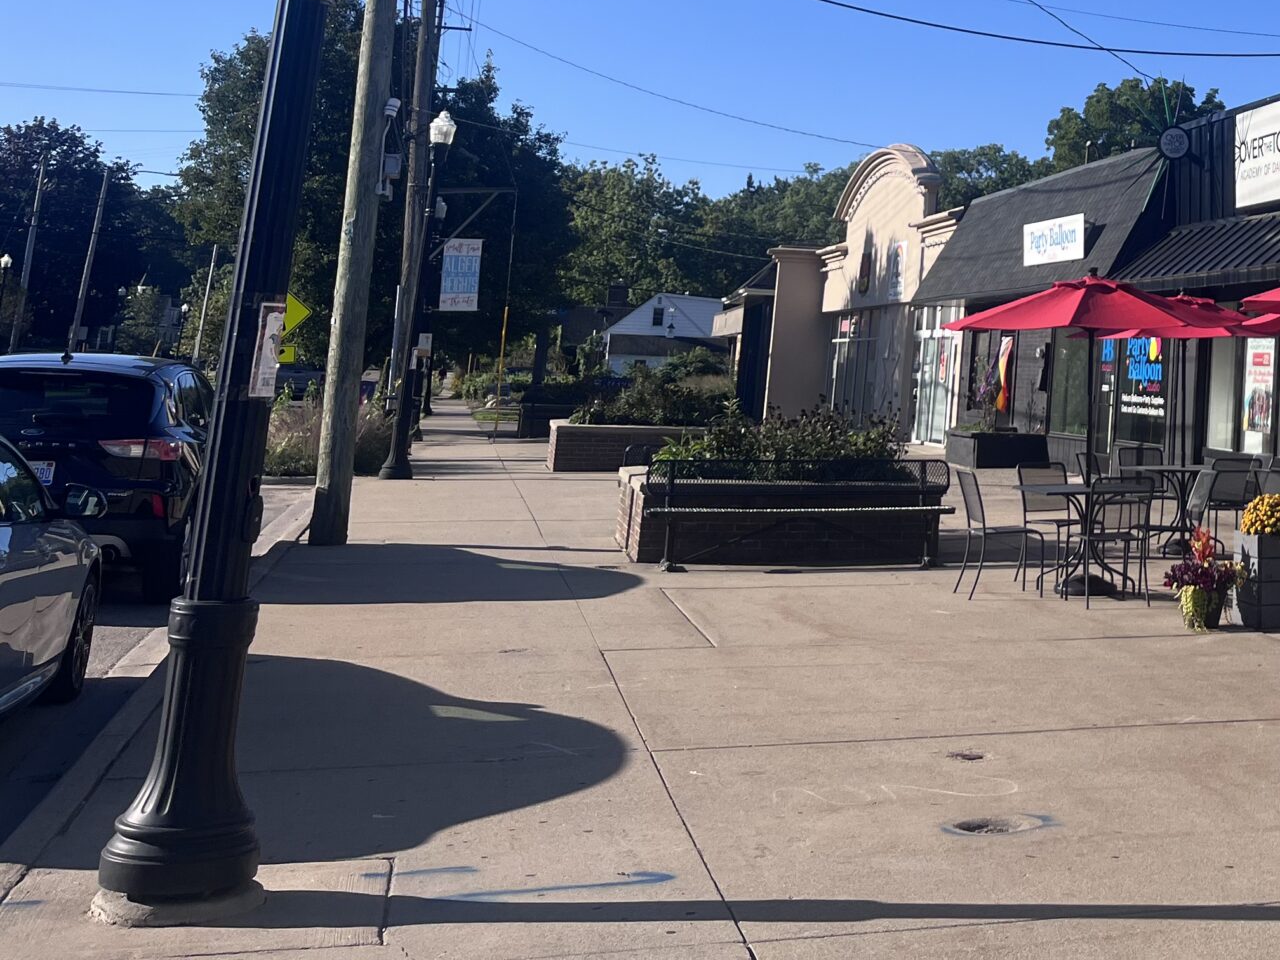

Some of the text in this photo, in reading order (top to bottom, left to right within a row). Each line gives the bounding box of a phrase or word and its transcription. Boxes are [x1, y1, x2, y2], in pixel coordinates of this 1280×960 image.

[1239, 137, 1264, 163] OVER
[1030, 224, 1077, 254] Party Balloon
[444, 256, 479, 272] ALGER
[1127, 336, 1150, 361] Party
[1128, 356, 1162, 387] Balloon
